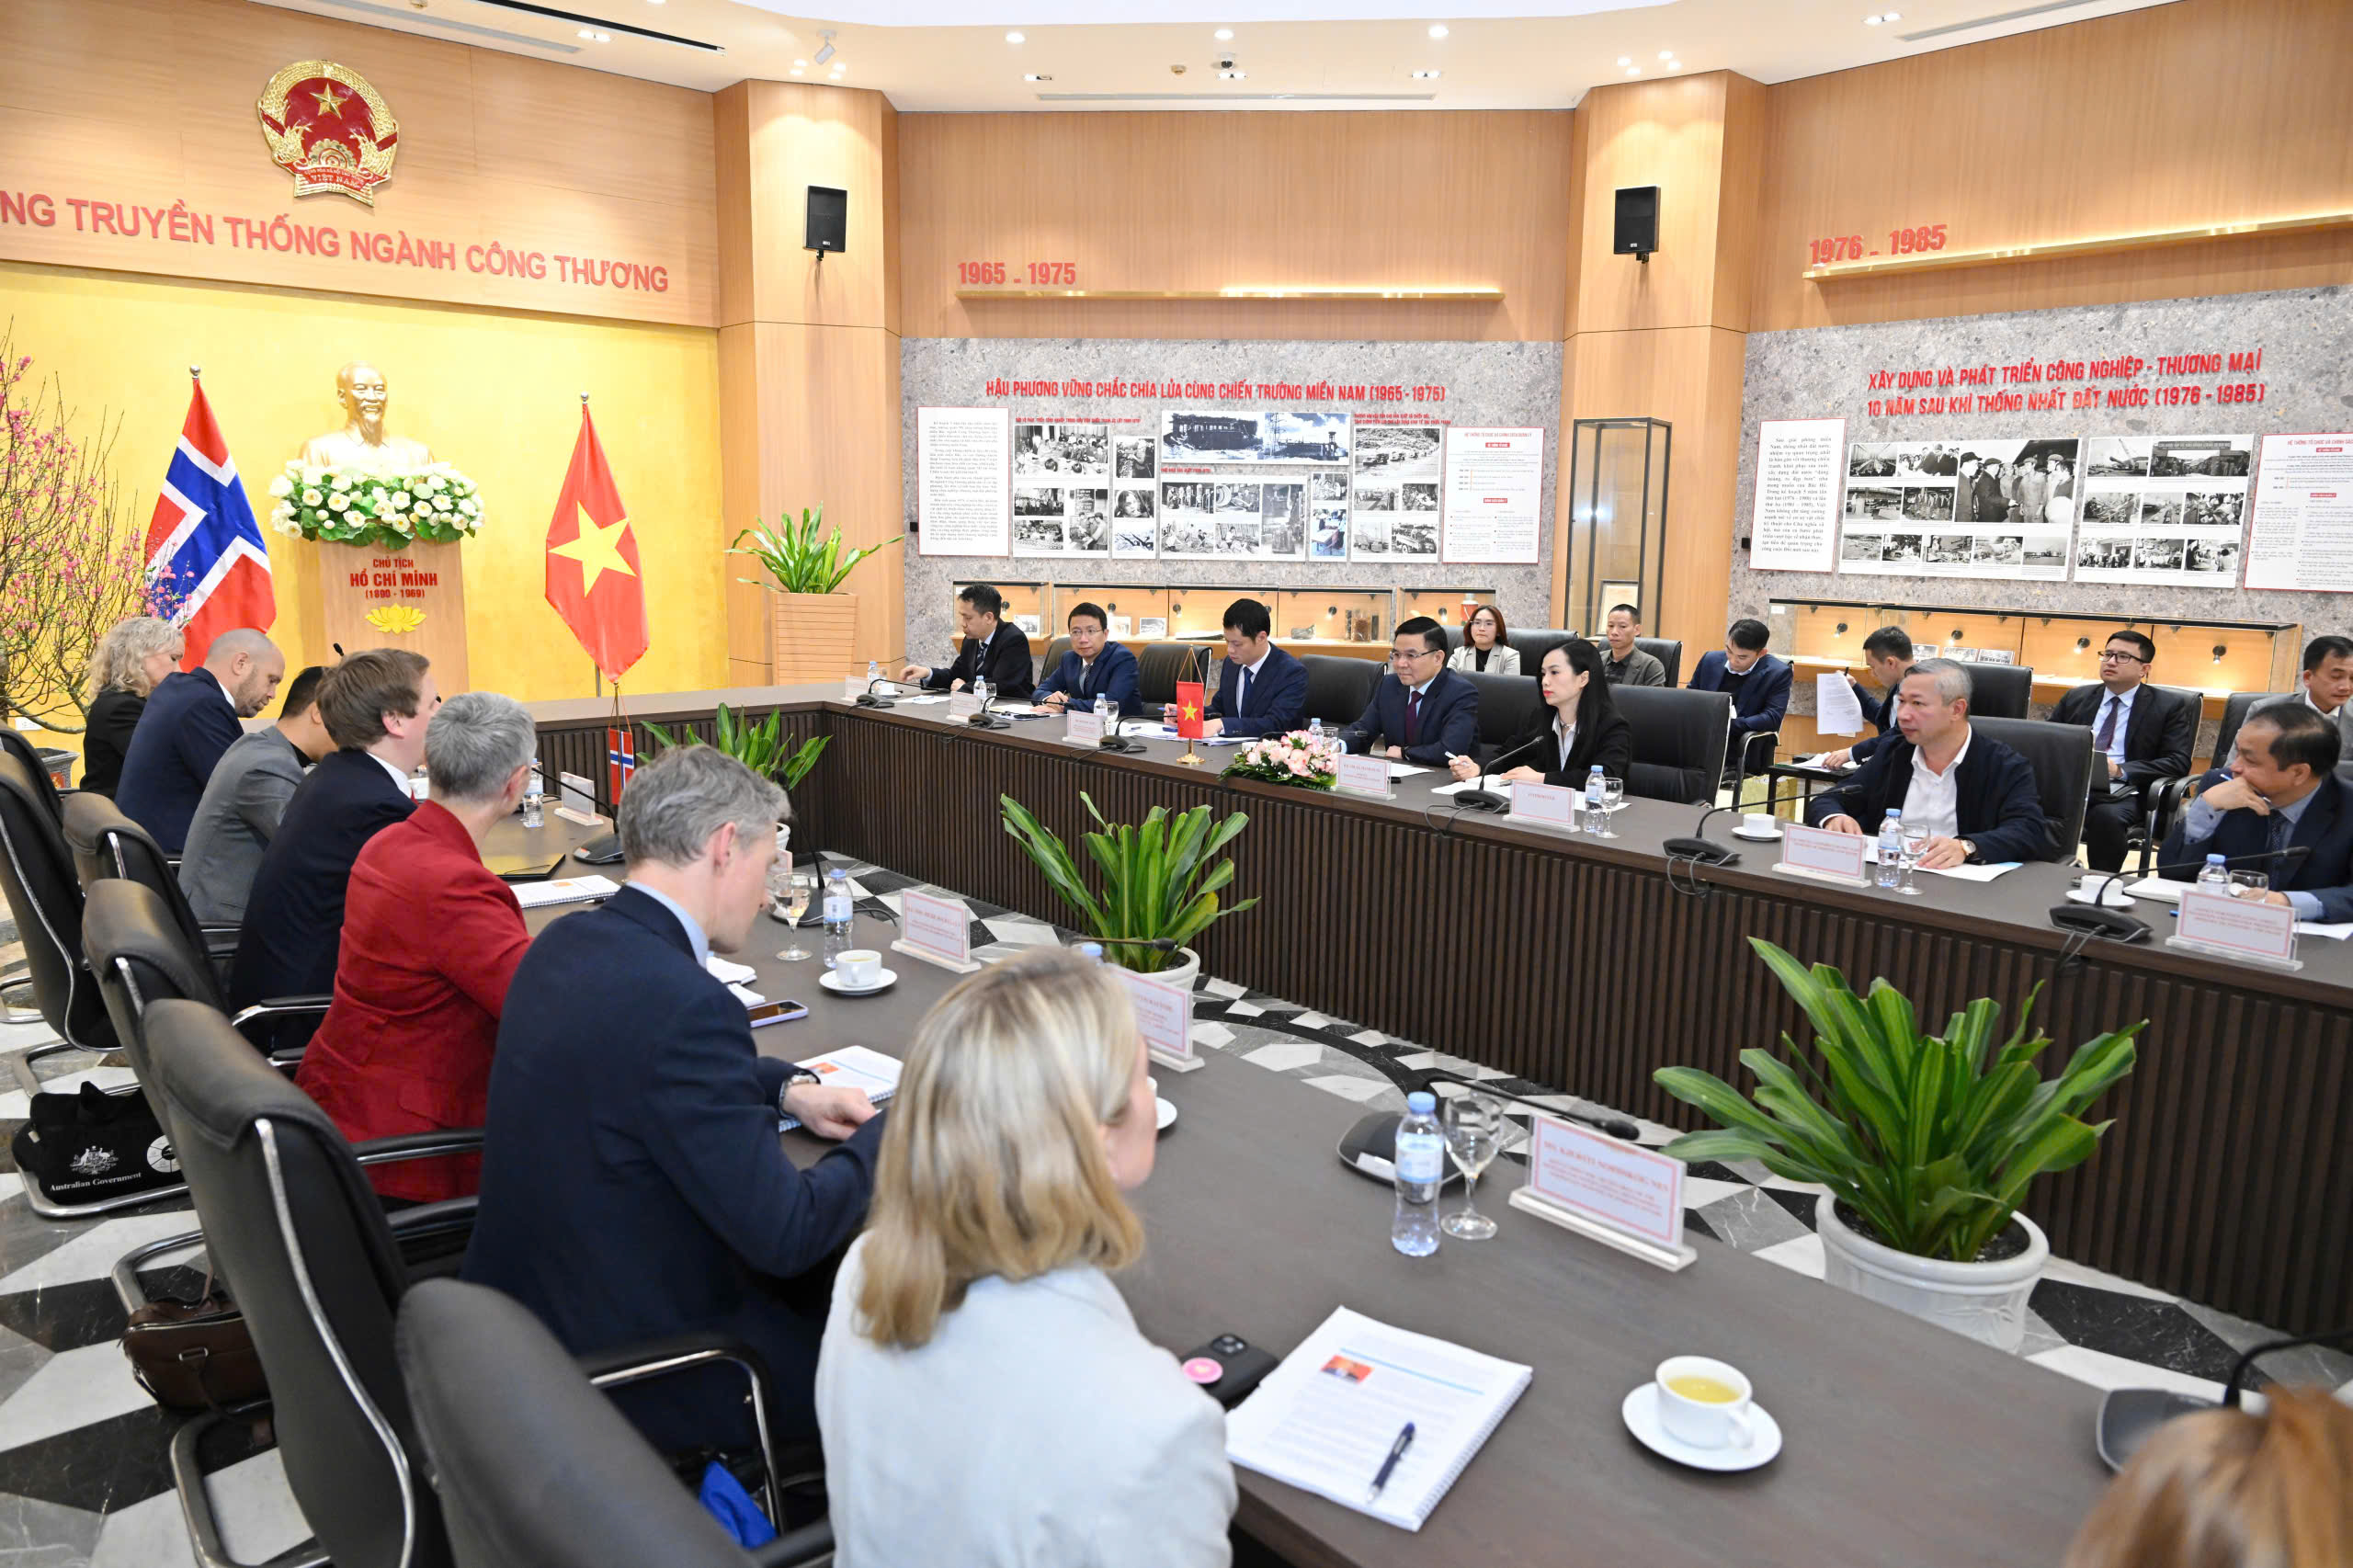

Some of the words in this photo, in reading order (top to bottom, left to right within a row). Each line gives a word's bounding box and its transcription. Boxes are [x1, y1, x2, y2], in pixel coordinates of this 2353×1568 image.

[65, 198, 215, 244] TRUYỀN
[222, 212, 341, 257] THỐNG
[349, 229, 457, 270] NGÀNH
[465, 240, 547, 279] CÔNG
[553, 254, 669, 292] THƯƠNG
[1809, 234, 1863, 265] 1976
[1889, 223, 1948, 256] 1985
[957, 261, 1006, 285] 1965
[1027, 261, 1076, 285] 1975
[1868, 369, 1895, 391] XÂY
[1897, 369, 1933, 392] DỰNG
[1937, 365, 1954, 387] VÀ
[1959, 363, 1996, 386] PHÁT
[2001, 356, 2042, 383] TRIỂN
[2045, 359, 2085, 381] CÔNG
[2088, 355, 2144, 381] NGHIỆP
[2156, 353, 2222, 376] THƯƠNG
[2228, 347, 2263, 375] MẠI
[985, 377, 1010, 399] HẬU
[1013, 380, 1058, 397] PHƯƠNG
[1062, 378, 1093, 398] VỮNG
[1096, 376, 1127, 398] CHẮC
[1130, 381, 1157, 398] CHIA
[1160, 378, 1183, 399] LỬA
[1185, 380, 1215, 399] CÙNG
[1219, 378, 1253, 399] CHIẾN
[1256, 381, 1302, 400] TRƯỜNG
[1338, 385, 1366, 401] NAM
[1867, 399, 1882, 417] 10
[1885, 396, 1916, 416] NĂM
[1918, 397, 1945, 415] SAU
[1949, 392, 1973, 414] KHI
[1976, 389, 2023, 413] THỐNG
[2027, 386, 2067, 411] NHẤT
[2072, 384, 2102, 409] ĐẤT
[2107, 383, 2149, 408] NƯỚC
[372, 555, 392, 568] CHỦ
[393, 556, 415, 570] TỊCH
[373, 570, 397, 587] CHÍ
[50, 1180, 91, 1192] Australian
[92, 1172, 142, 1187] Government
